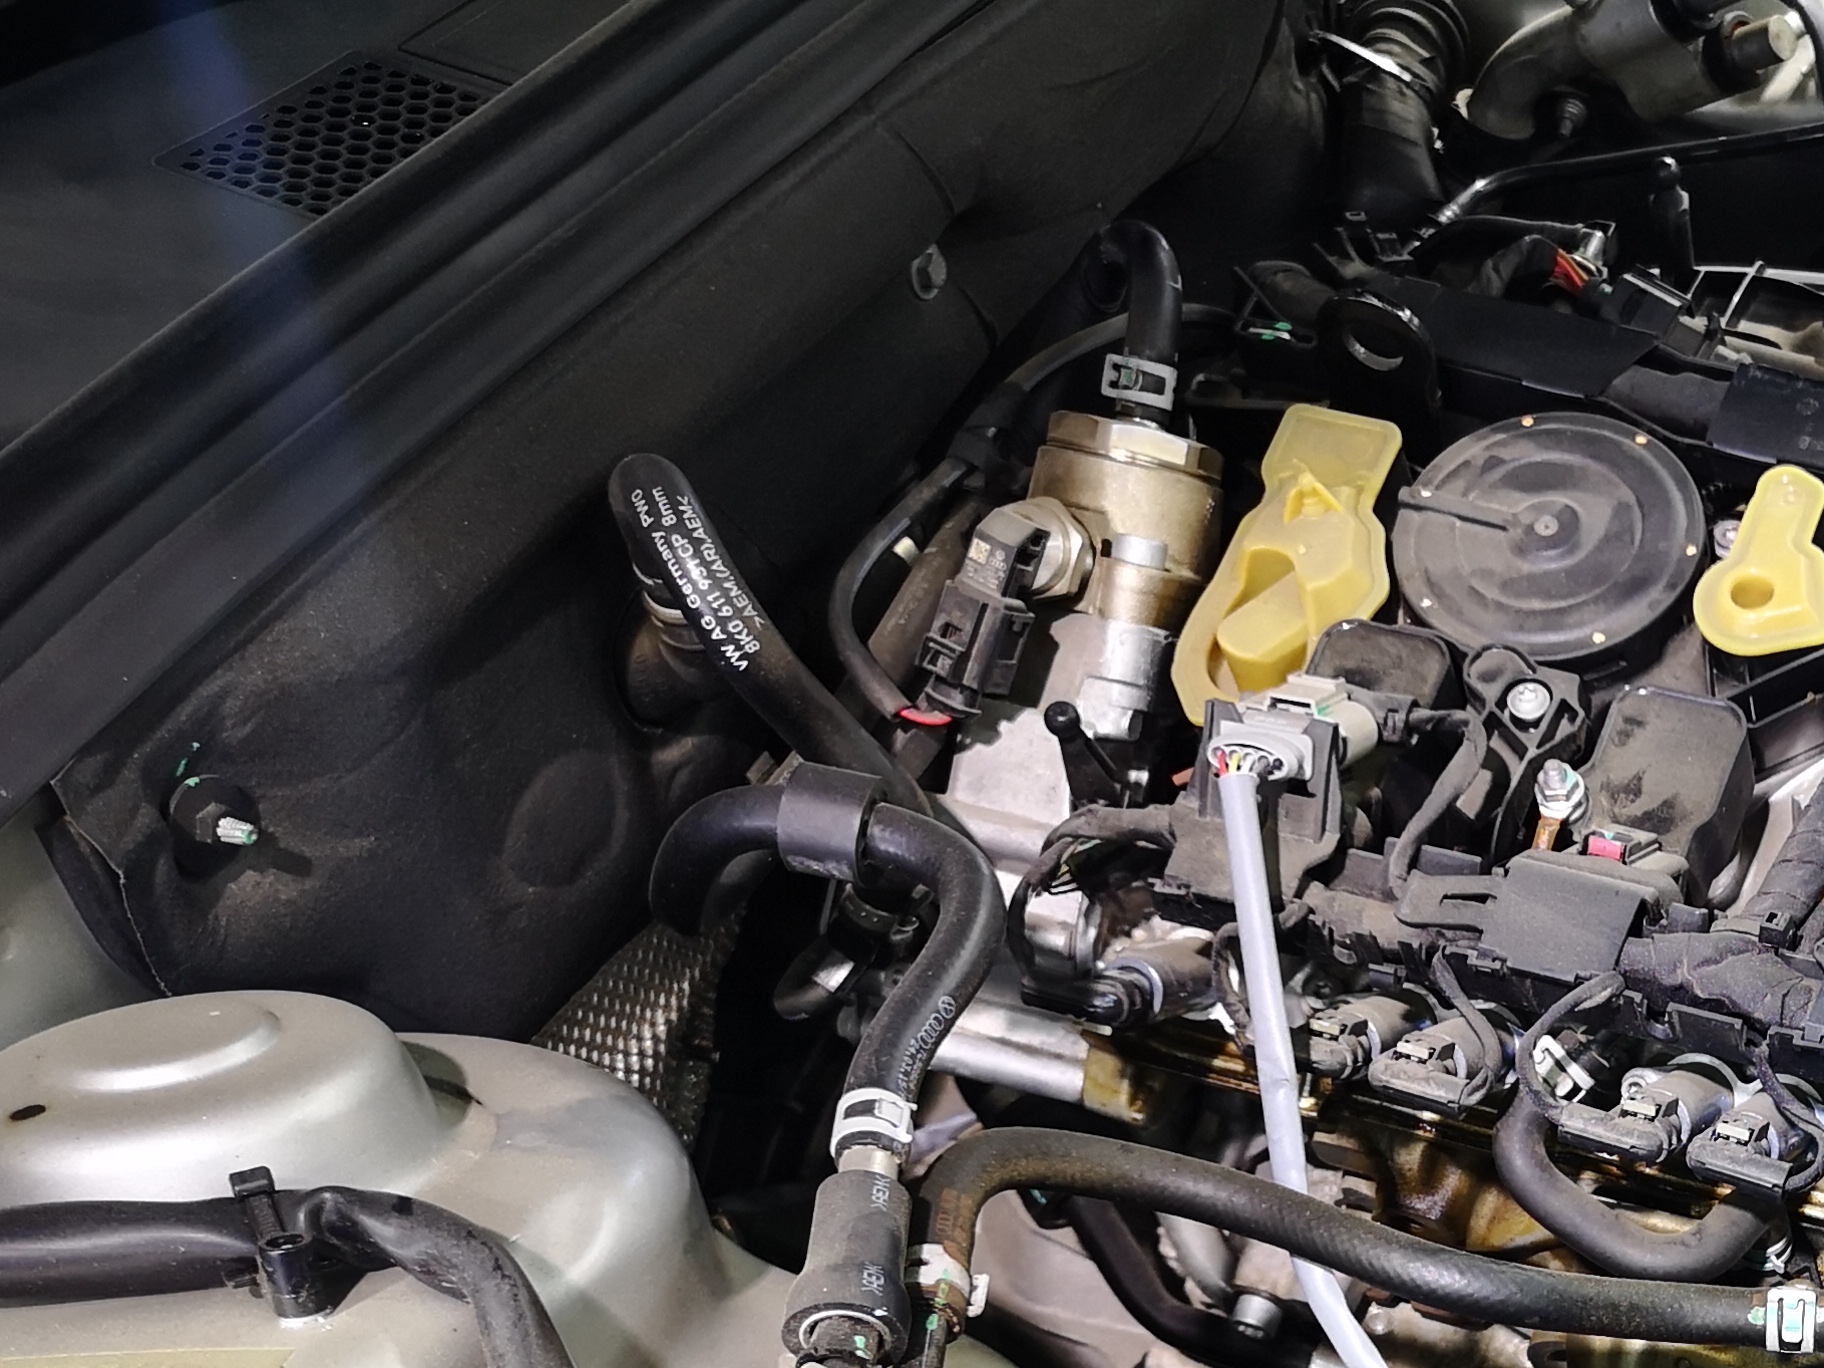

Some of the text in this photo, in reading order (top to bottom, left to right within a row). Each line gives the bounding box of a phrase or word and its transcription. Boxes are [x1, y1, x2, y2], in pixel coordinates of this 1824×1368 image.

[652, 486, 677, 527] 8mm
[651, 531, 701, 609] Germany
[700, 615, 728, 640] AG
[720, 643, 749, 671] VW
